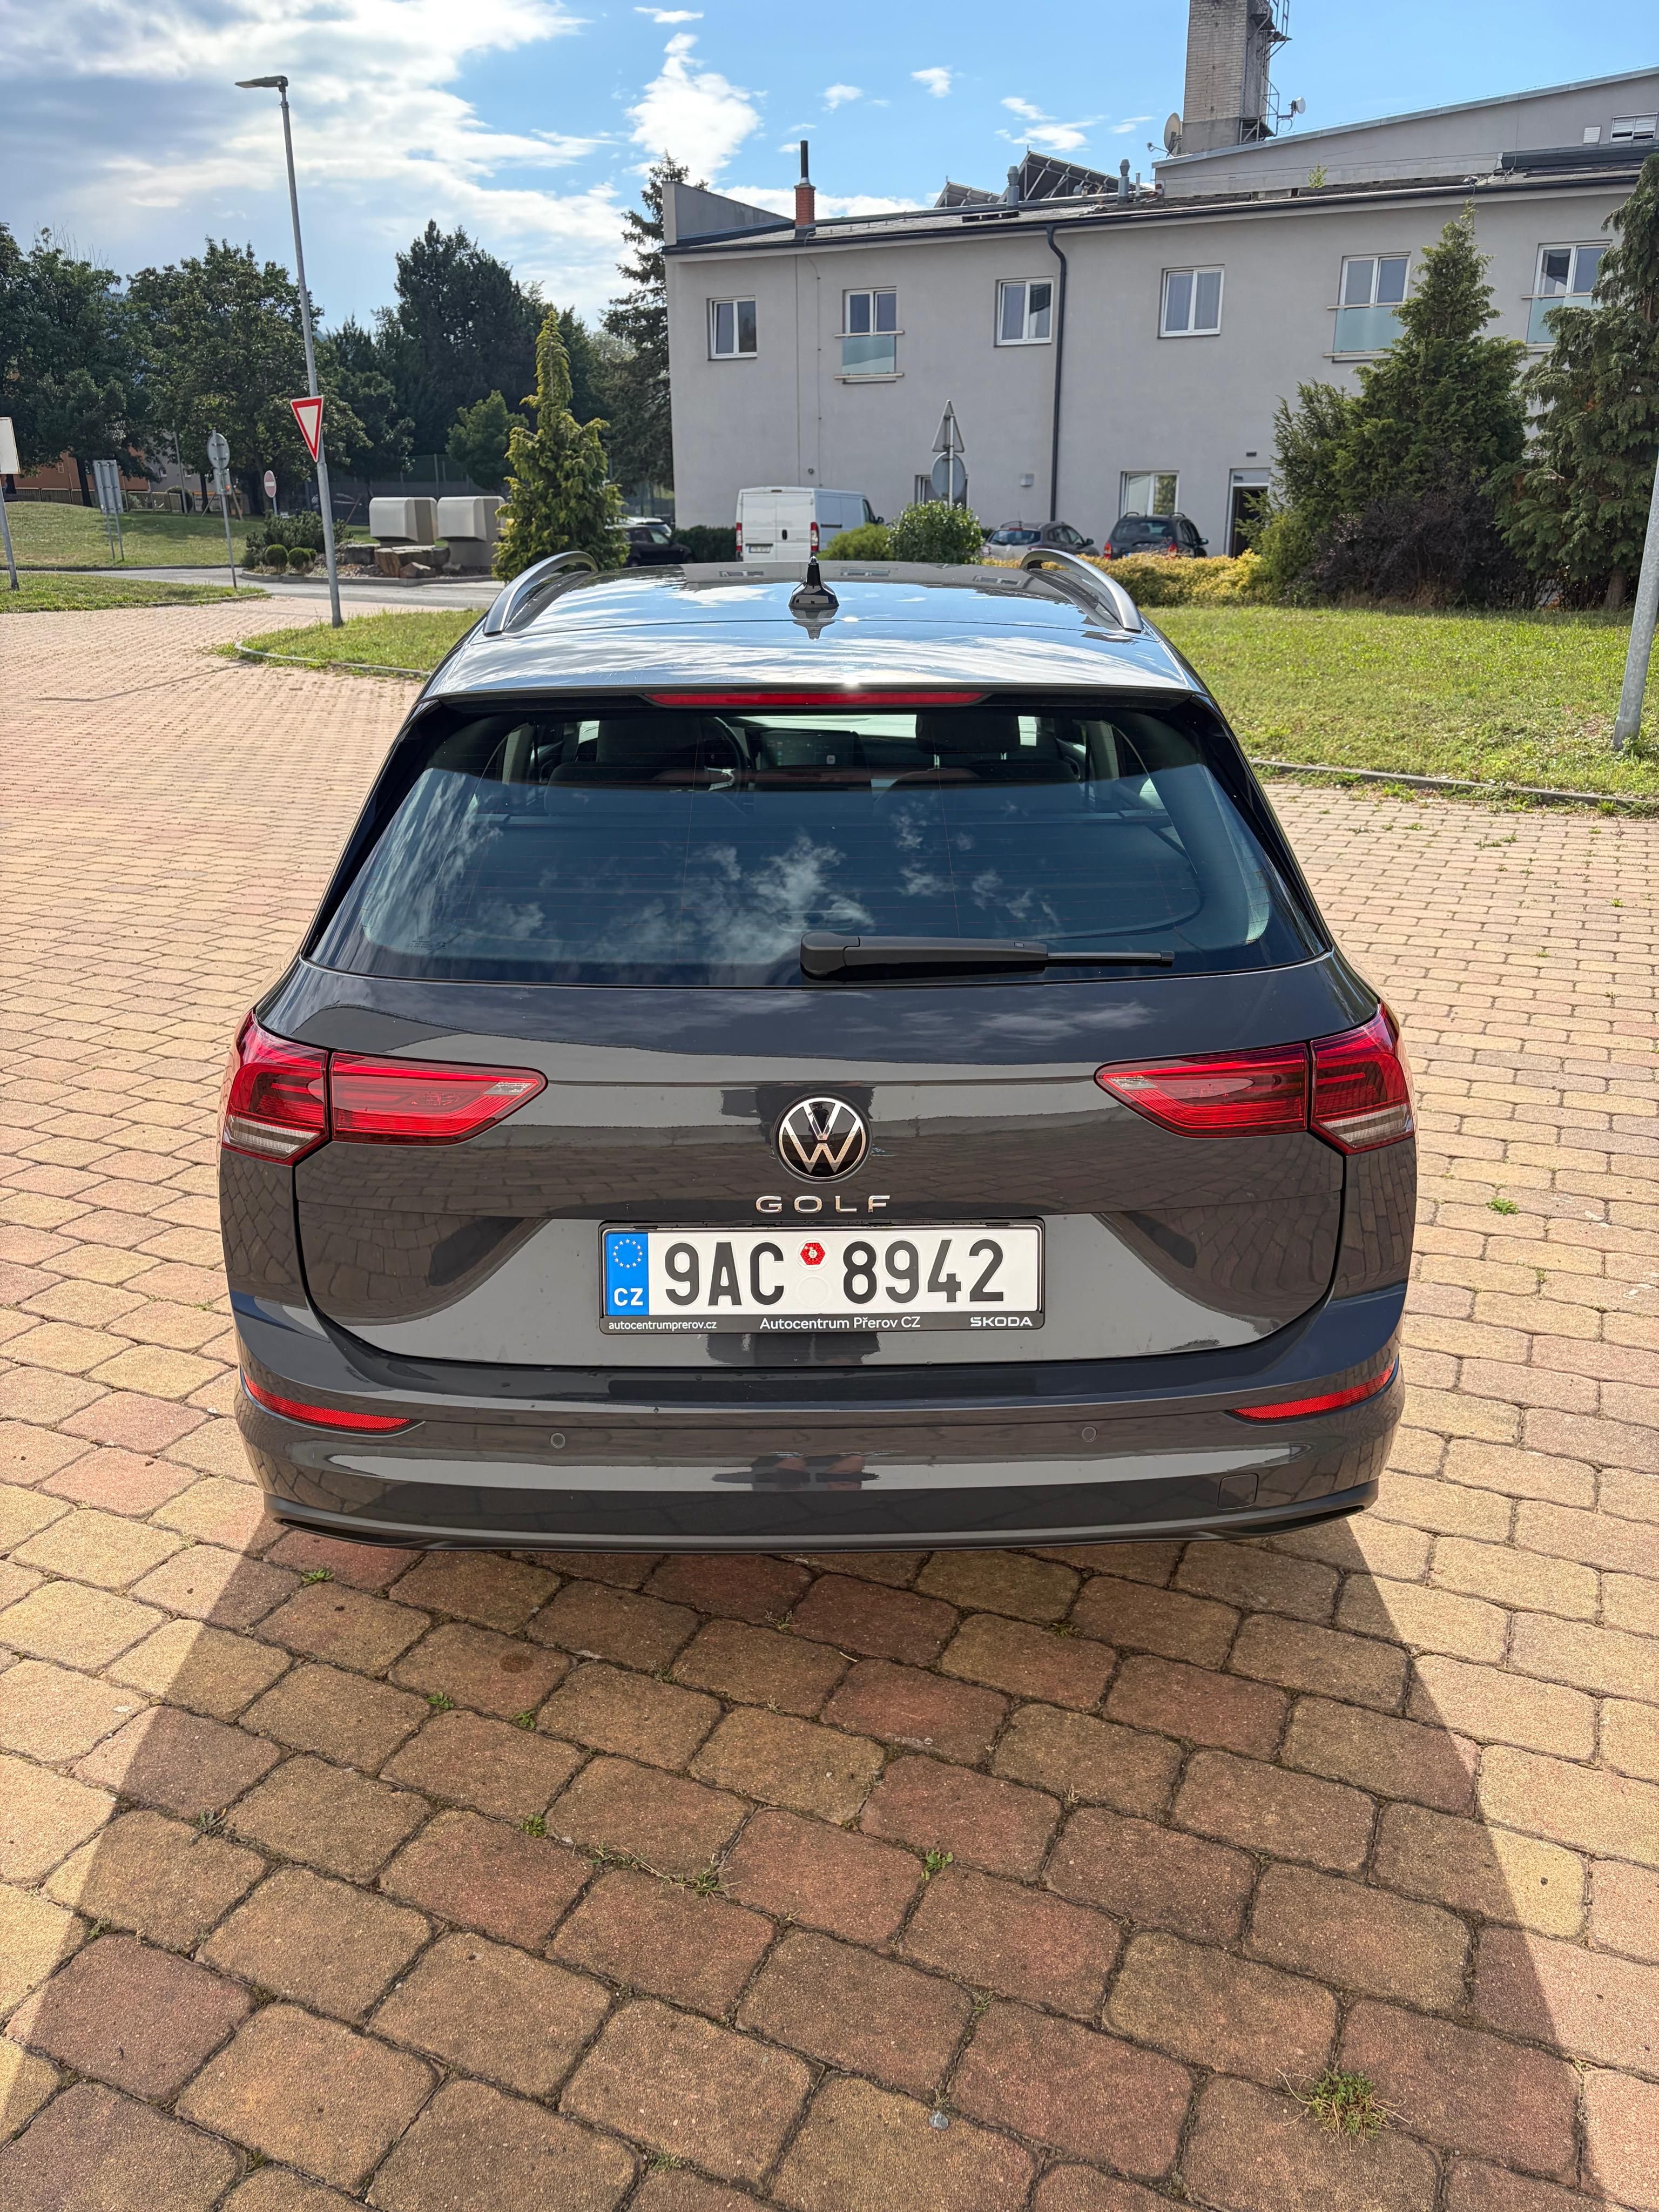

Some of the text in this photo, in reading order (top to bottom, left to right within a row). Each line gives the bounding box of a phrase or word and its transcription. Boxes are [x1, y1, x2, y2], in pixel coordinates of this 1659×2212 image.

[756, 1195, 891, 1214] GOLF
[665, 1239, 1004, 1306] 9AC 8942
[613, 1287, 643, 1306] CZ
[608, 1320, 717, 1331] autocentrumprerov.cz
[759, 1317, 921, 1330] Autocentrum Přerov CZ
